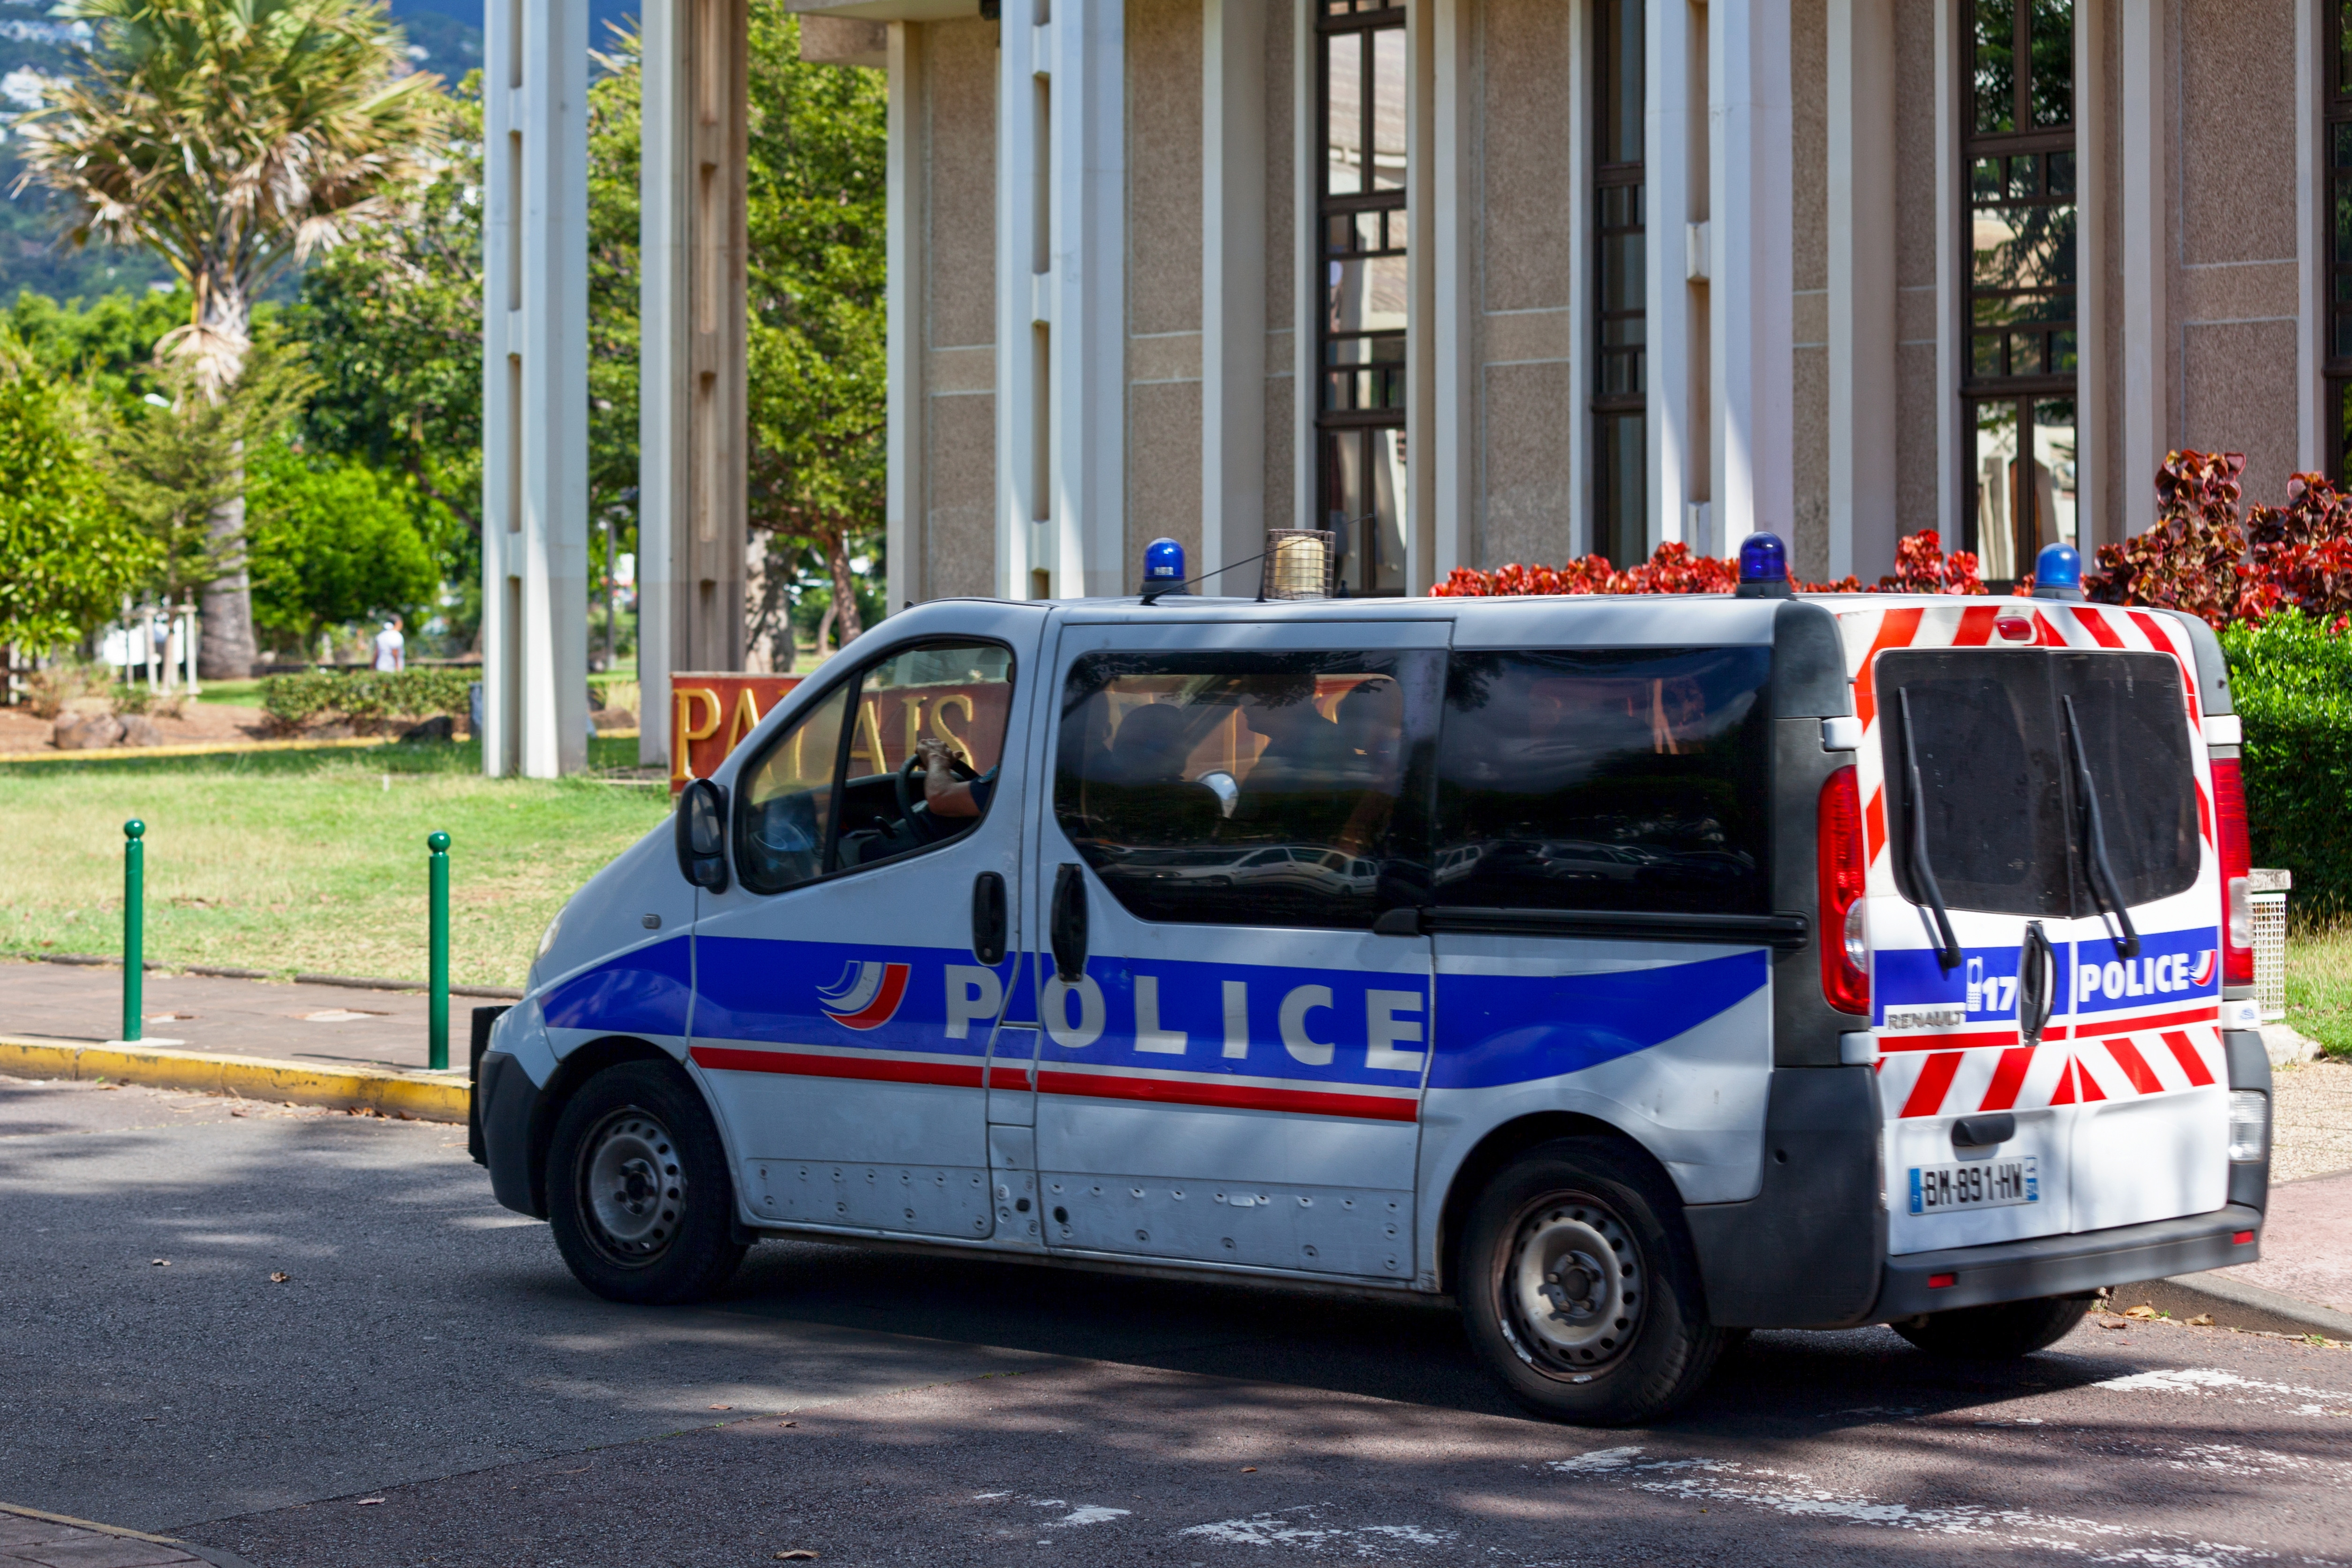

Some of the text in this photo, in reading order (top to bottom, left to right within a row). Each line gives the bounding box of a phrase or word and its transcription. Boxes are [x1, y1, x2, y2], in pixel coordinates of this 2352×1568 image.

[1982, 976, 2018, 1011] 17
[2079, 953, 2189, 1003] POLICE
[944, 964, 1426, 1072] POLICE
[1887, 1010, 1966, 1030] RENAULT
